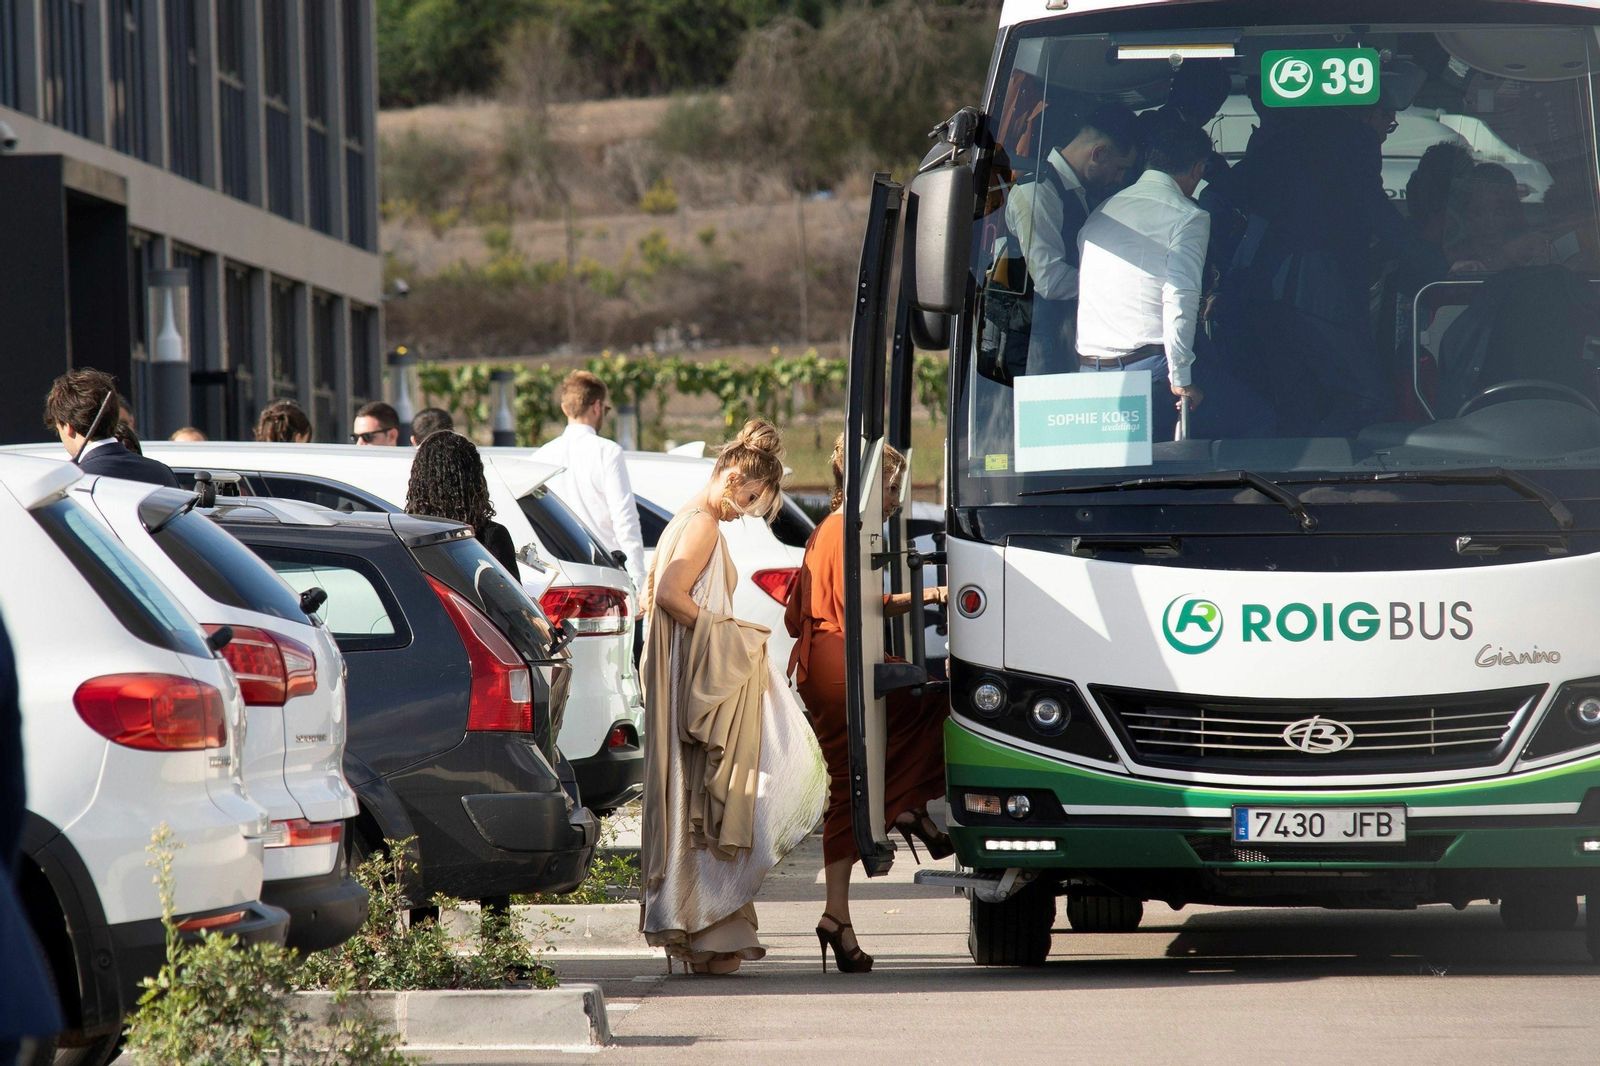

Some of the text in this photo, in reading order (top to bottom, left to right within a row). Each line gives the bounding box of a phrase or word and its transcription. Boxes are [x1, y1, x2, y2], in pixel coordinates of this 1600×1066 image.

[1321, 57, 1374, 95] 39
[1047, 410, 1140, 427] SOPHIE KORS
[1101, 422, 1140, 433] weddings
[1475, 643, 1561, 668] Gianino
[1239, 827, 1246, 836] E
[1255, 812, 1393, 838] 7430 JFB
